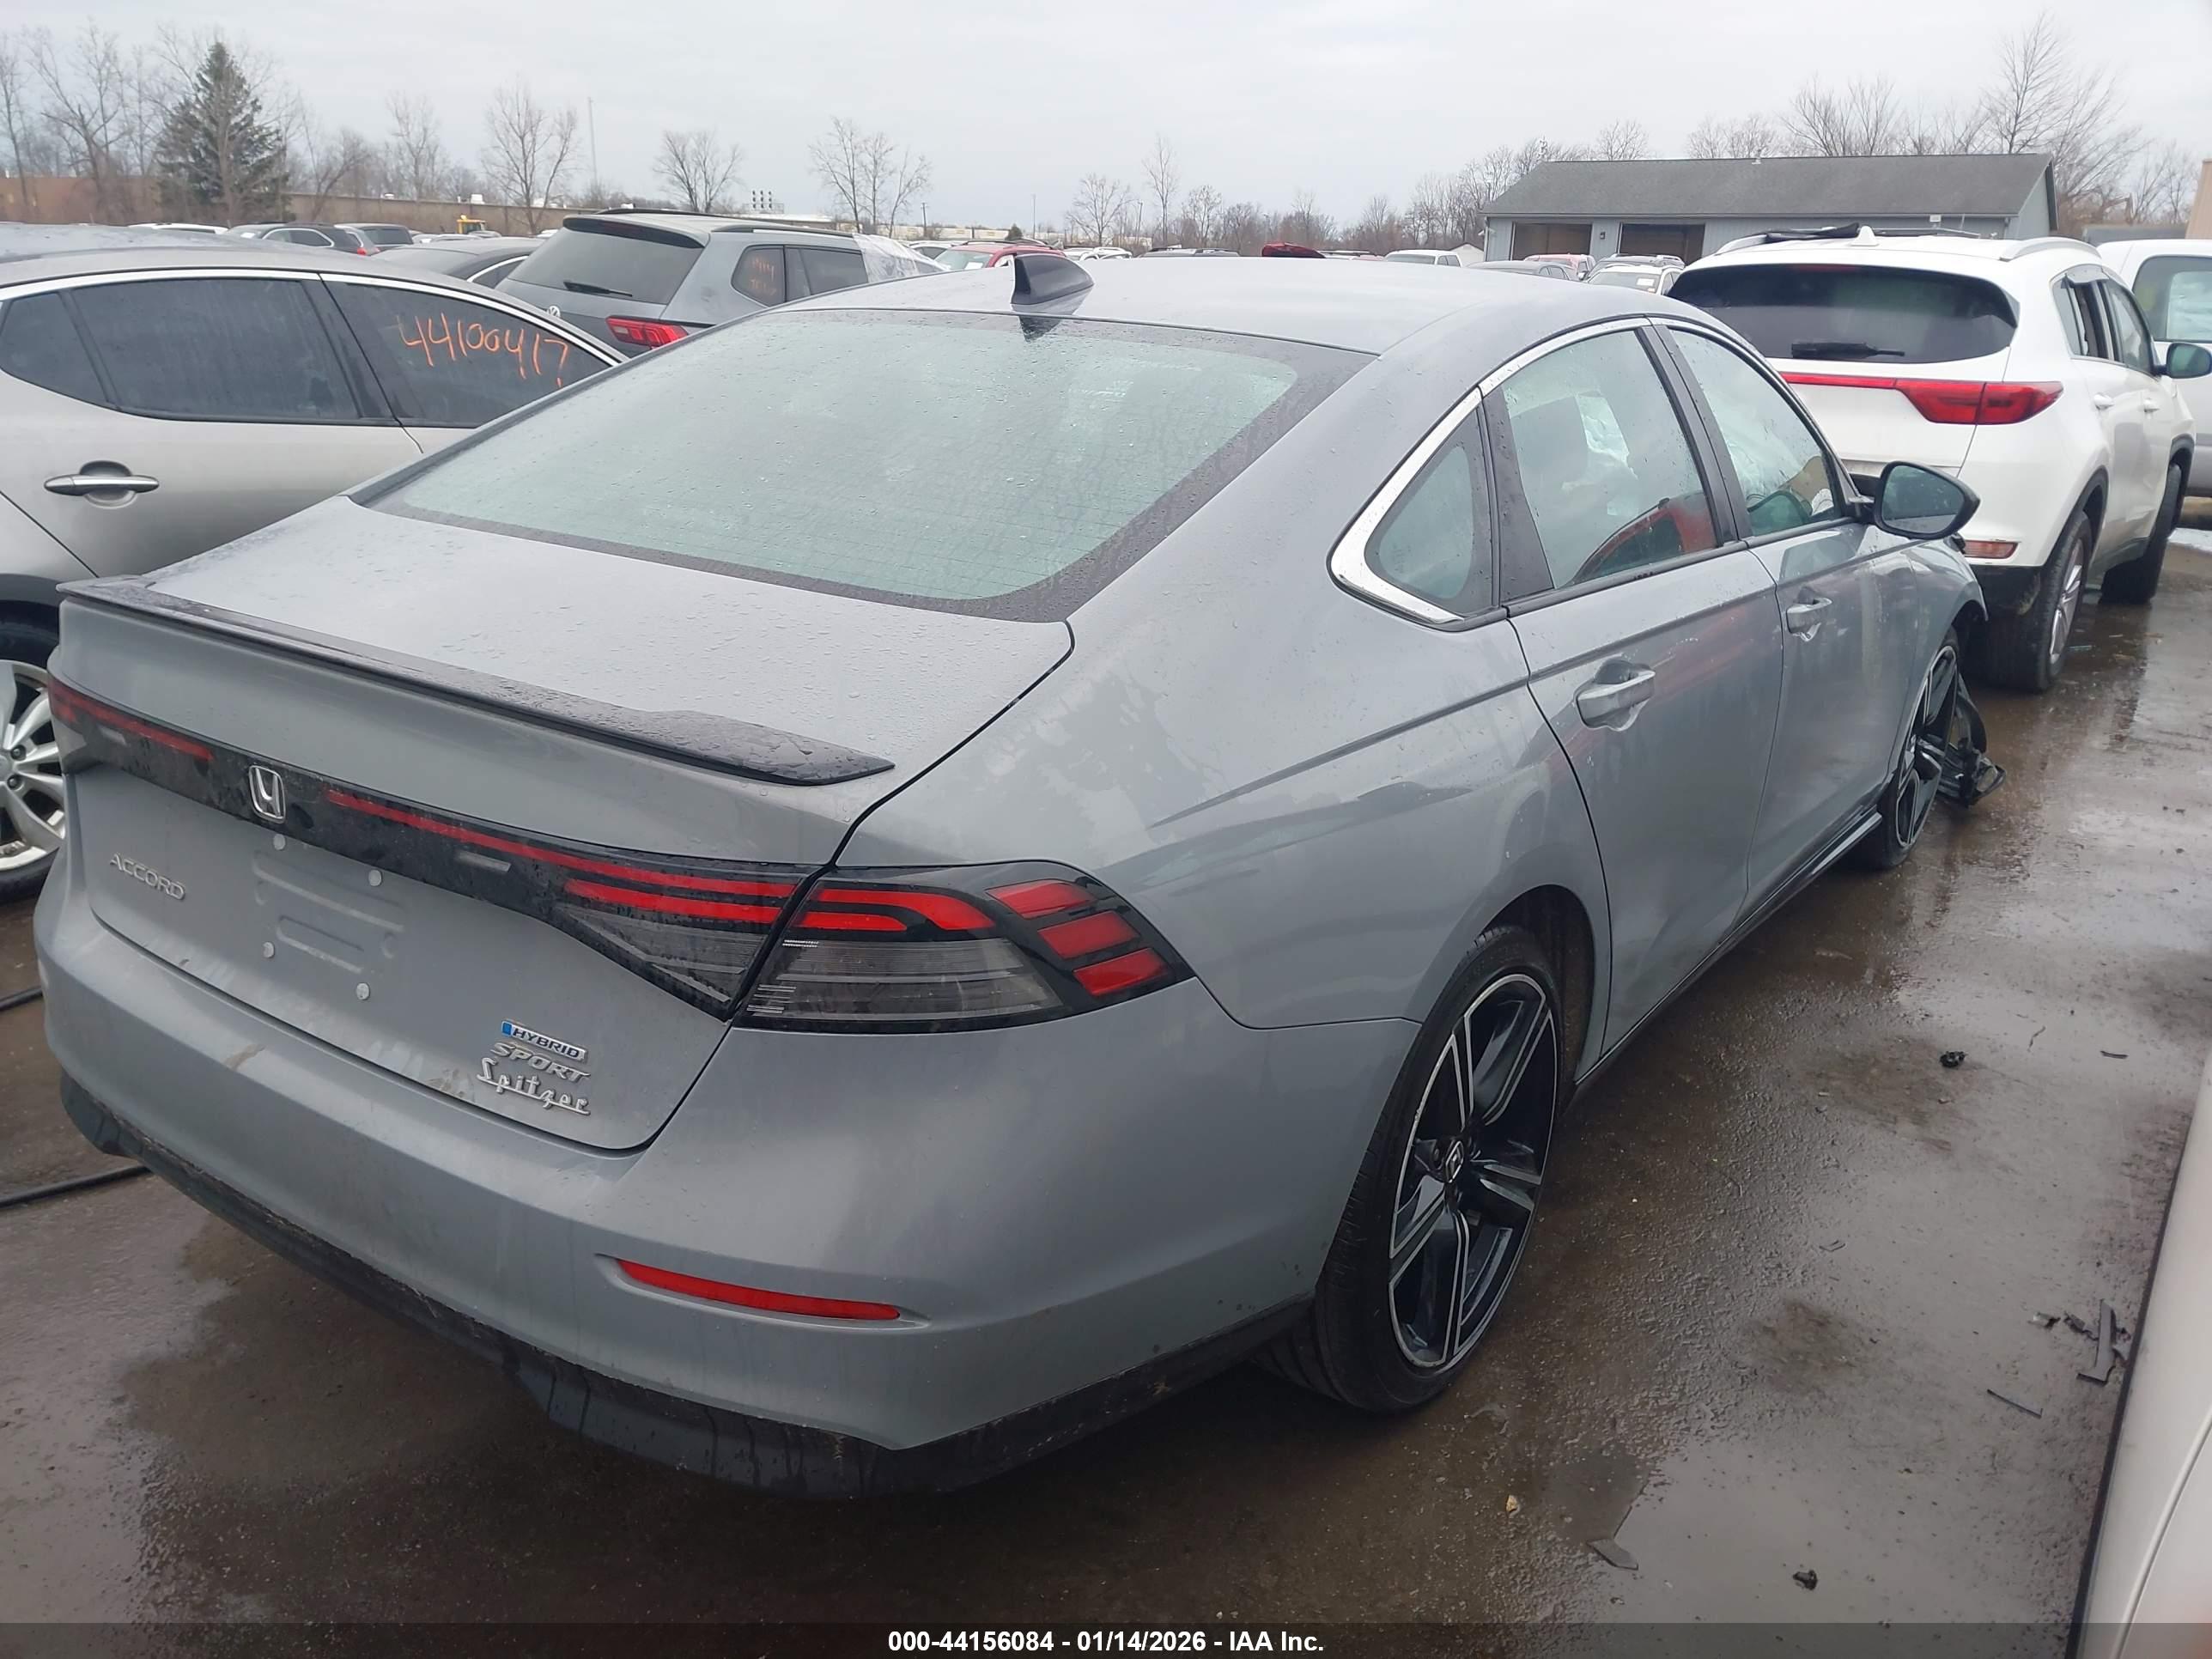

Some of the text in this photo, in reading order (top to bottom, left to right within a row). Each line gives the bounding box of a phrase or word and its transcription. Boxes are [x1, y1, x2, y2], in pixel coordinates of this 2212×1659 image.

[109, 852, 185, 900] ACCORD
[489, 1042, 591, 1082] SPORT
[512, 1027, 580, 1058] HYBRID
[476, 1057, 591, 1115] Spitzer
